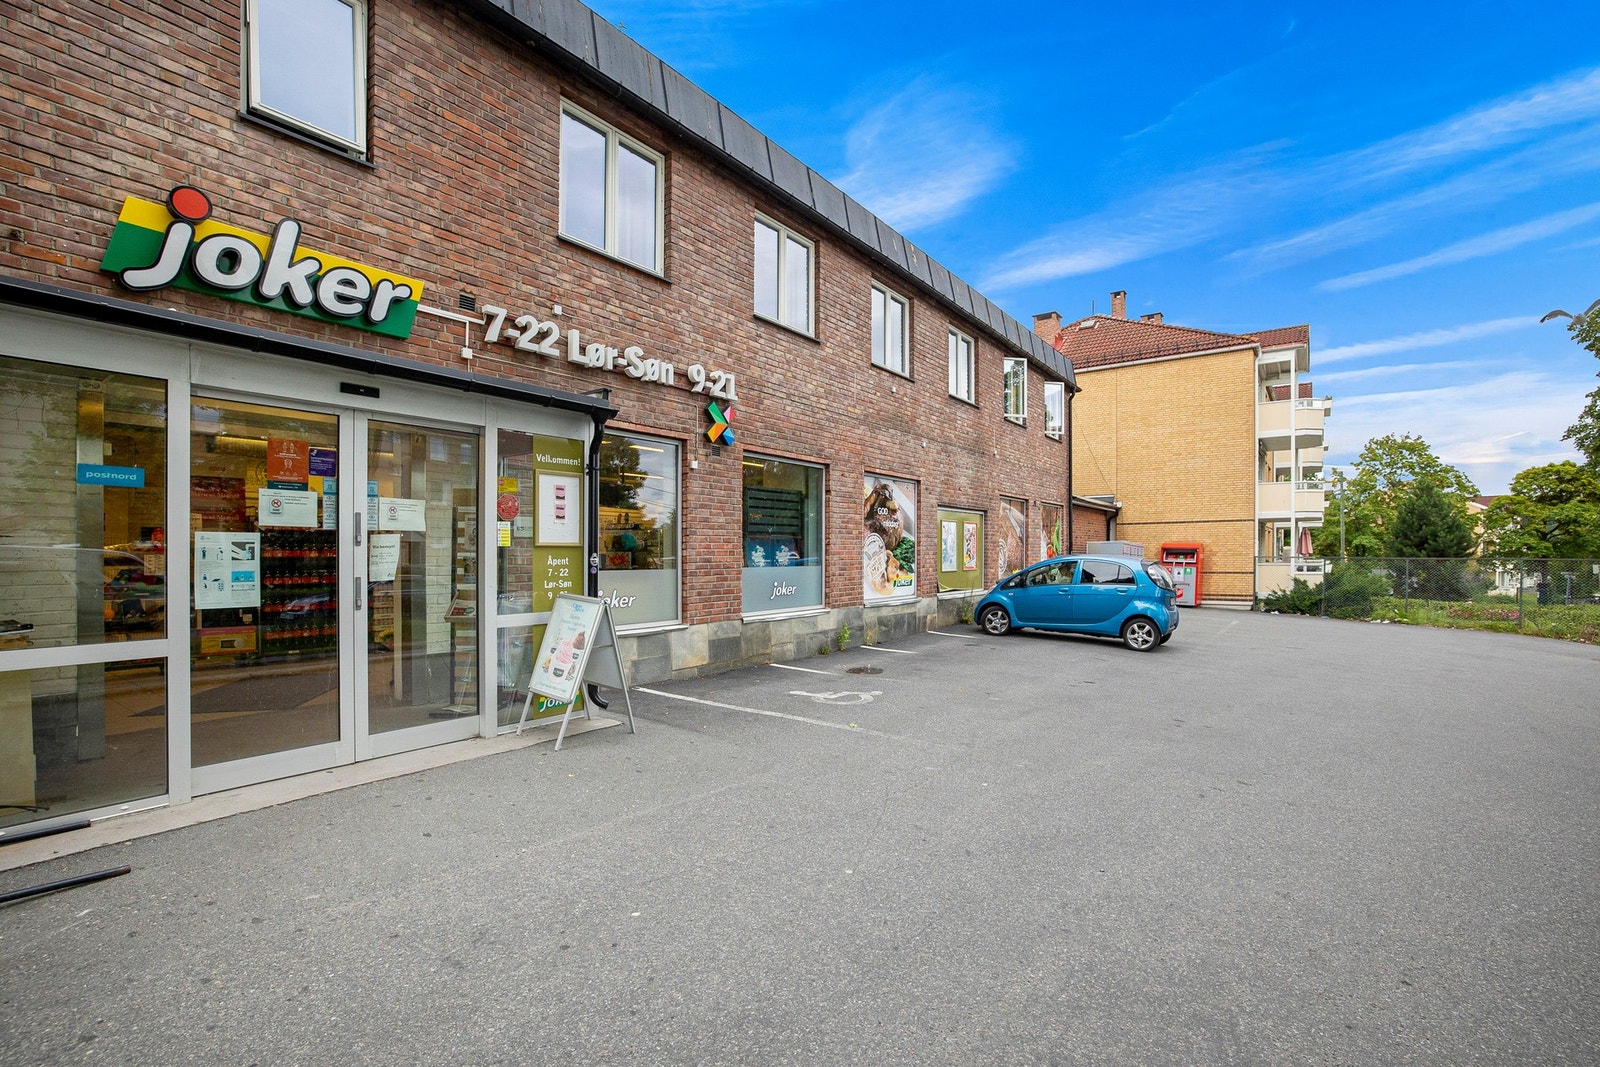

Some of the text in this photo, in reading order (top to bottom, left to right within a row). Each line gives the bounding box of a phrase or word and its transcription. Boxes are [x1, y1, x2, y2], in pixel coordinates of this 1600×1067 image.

[119, 184, 416, 324] joker
[481, 304, 739, 401] 7-22 Lør-Søn 9-21
[536, 453, 581, 466] Velkommen!
[85, 471, 137, 481] postnord
[547, 554, 569, 567] Åpent
[547, 568, 553, 577] 7
[559, 567, 569, 577] 22
[544, 579, 573, 589] Lør-Søn
[770, 581, 797, 600] joker
[547, 591, 553, 600] 9
[597, 588, 637, 609] oker
